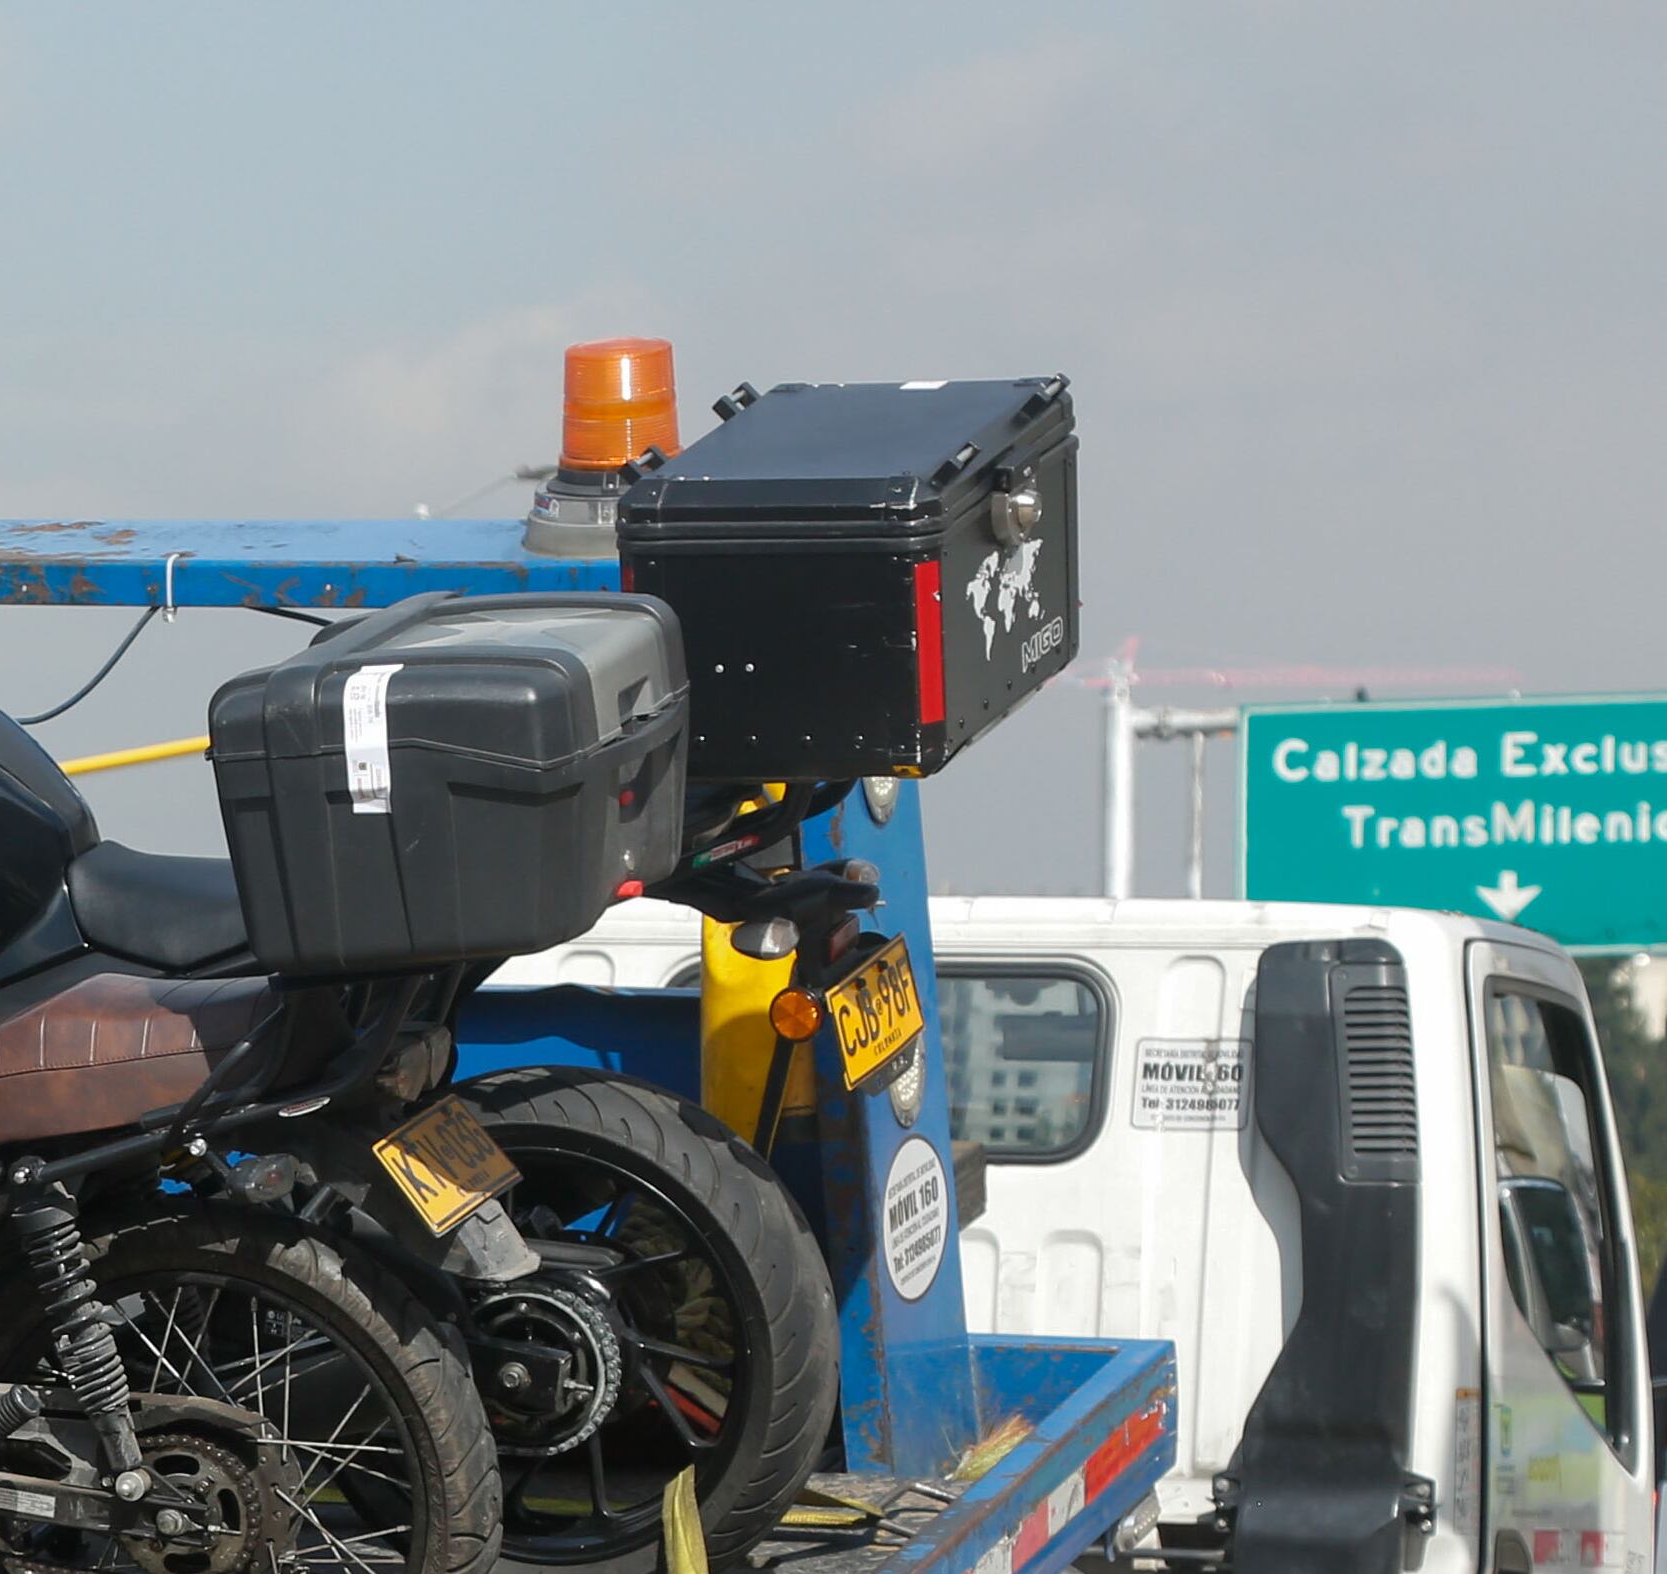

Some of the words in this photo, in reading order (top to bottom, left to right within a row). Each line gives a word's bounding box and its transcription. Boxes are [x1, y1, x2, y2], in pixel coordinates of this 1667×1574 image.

[1021, 615, 1064, 674] MIGO
[1272, 738, 1479, 783] Calzada
[1142, 1061, 1204, 1082] MÓVIL
[1208, 1062, 1244, 1082] 60
[888, 1192, 918, 1234] MÓVIL
[919, 1175, 939, 1210] 160
